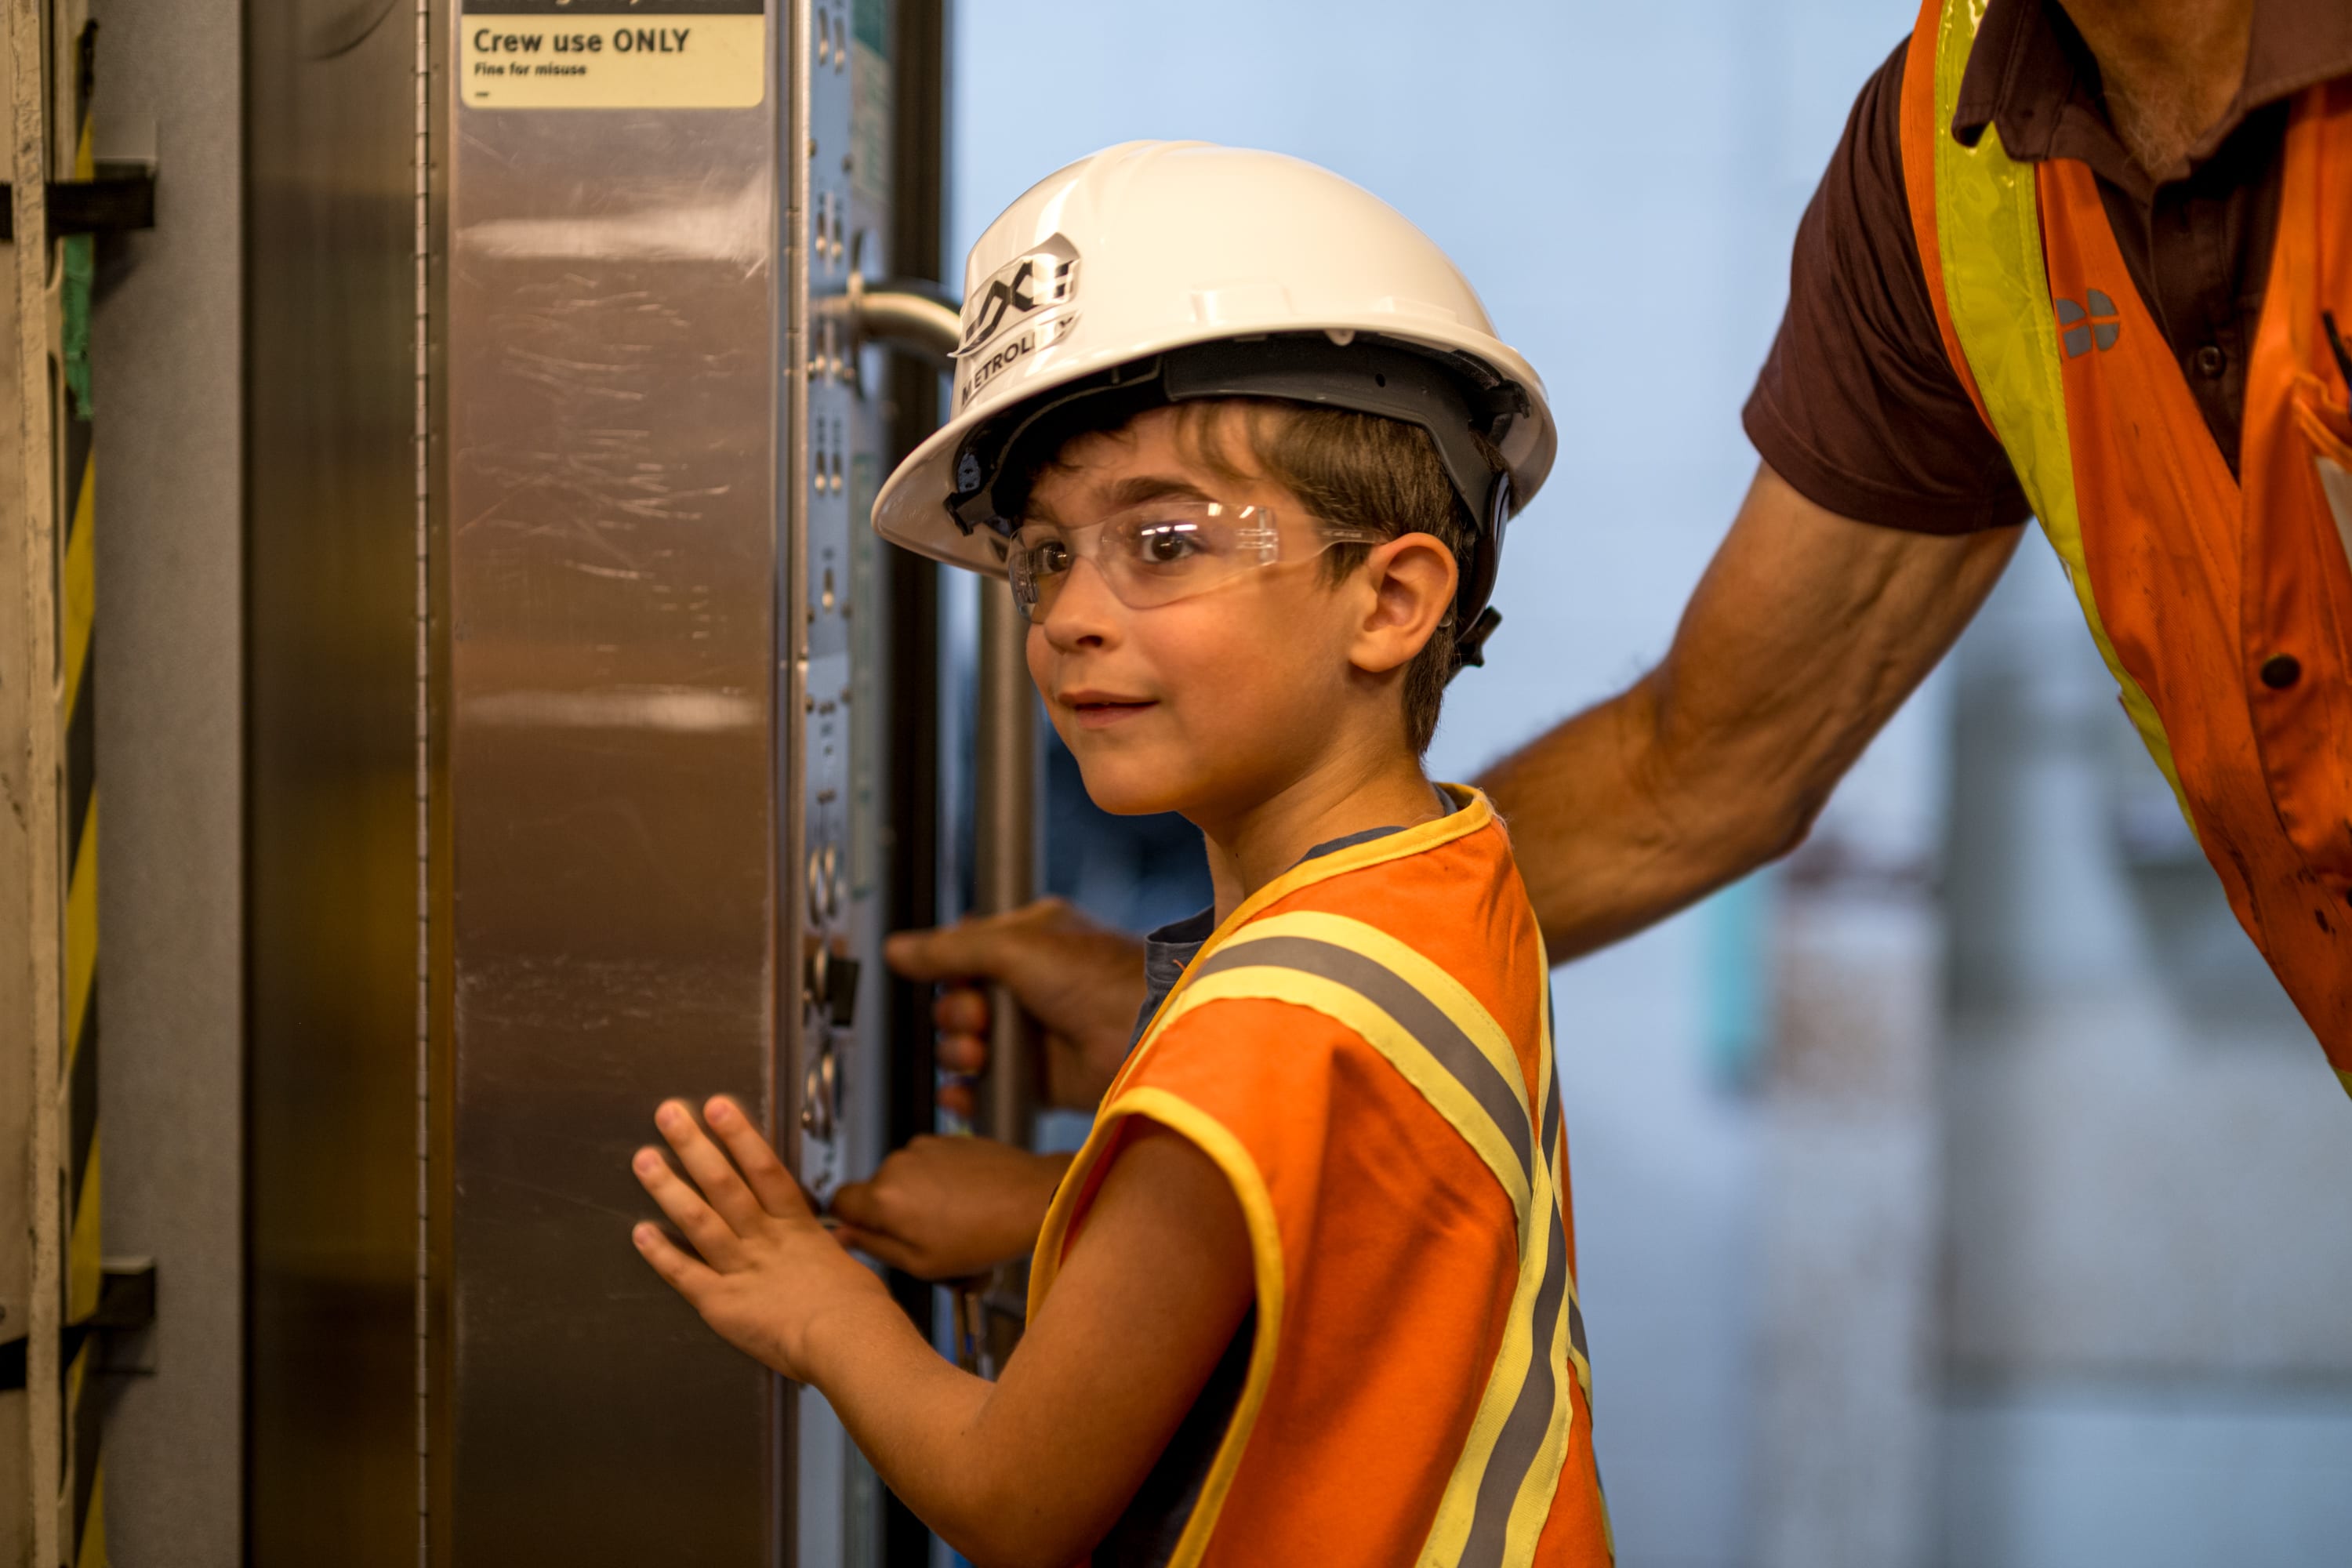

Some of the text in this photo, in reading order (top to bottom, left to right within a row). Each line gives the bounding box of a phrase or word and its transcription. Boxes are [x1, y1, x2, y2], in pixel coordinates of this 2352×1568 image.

[474, 28, 690, 53] Crew use ONLY
[474, 62, 586, 76] Fine for misuse
